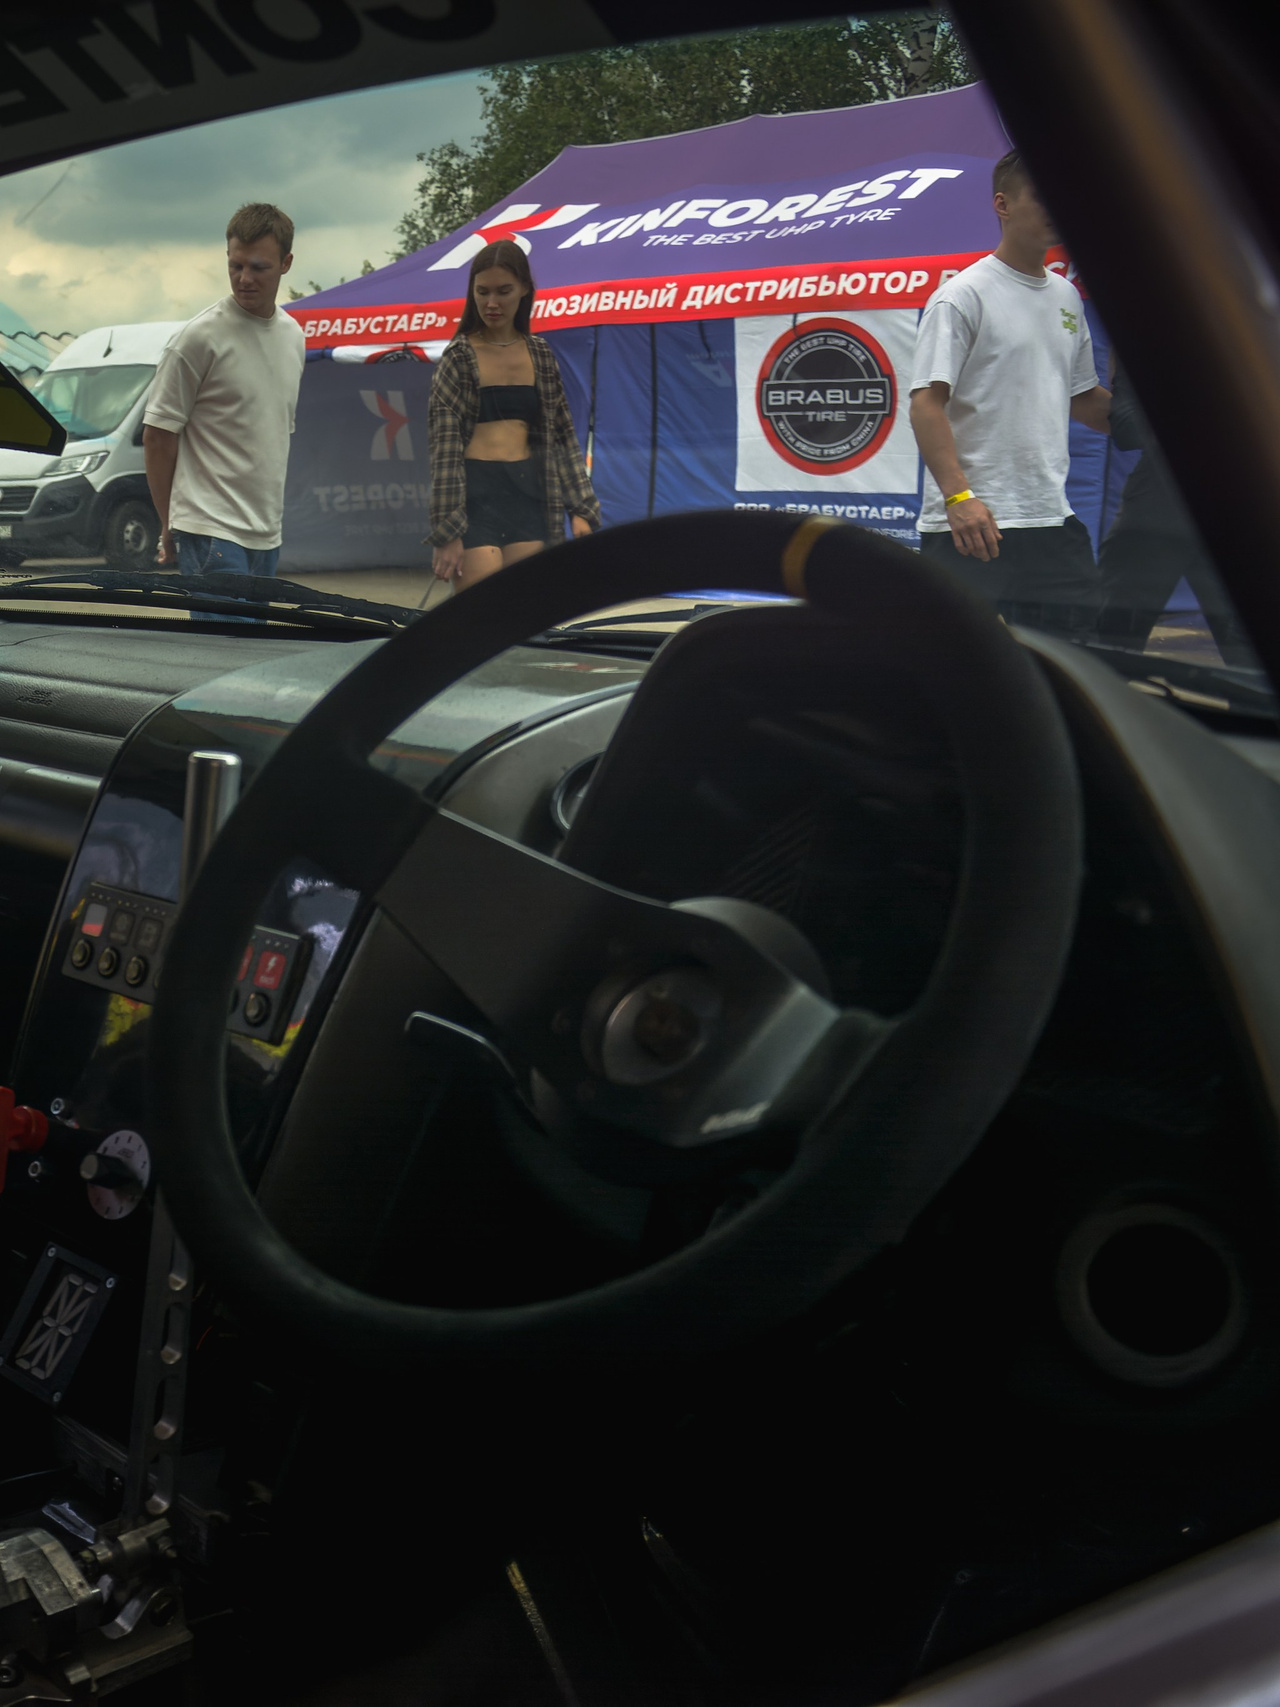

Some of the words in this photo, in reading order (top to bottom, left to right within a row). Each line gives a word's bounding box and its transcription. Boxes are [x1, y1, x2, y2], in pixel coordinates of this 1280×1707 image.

[557, 168, 964, 250] KINFOREST
[642, 233, 689, 248] THE
[692, 229, 765, 246] BEST
[764, 219, 826, 240] UHP
[828, 207, 902, 229] TYRE
[302, 311, 448, 338] БРАБУСТАЕР»
[529, 282, 678, 320] ЛЮЗИВНЫЙ
[680, 269, 929, 311] ДИСТРИБЬЮТОР
[800, 336, 826, 351] BEST
[767, 387, 885, 406] BRABUS
[805, 410, 848, 423] TIRE
